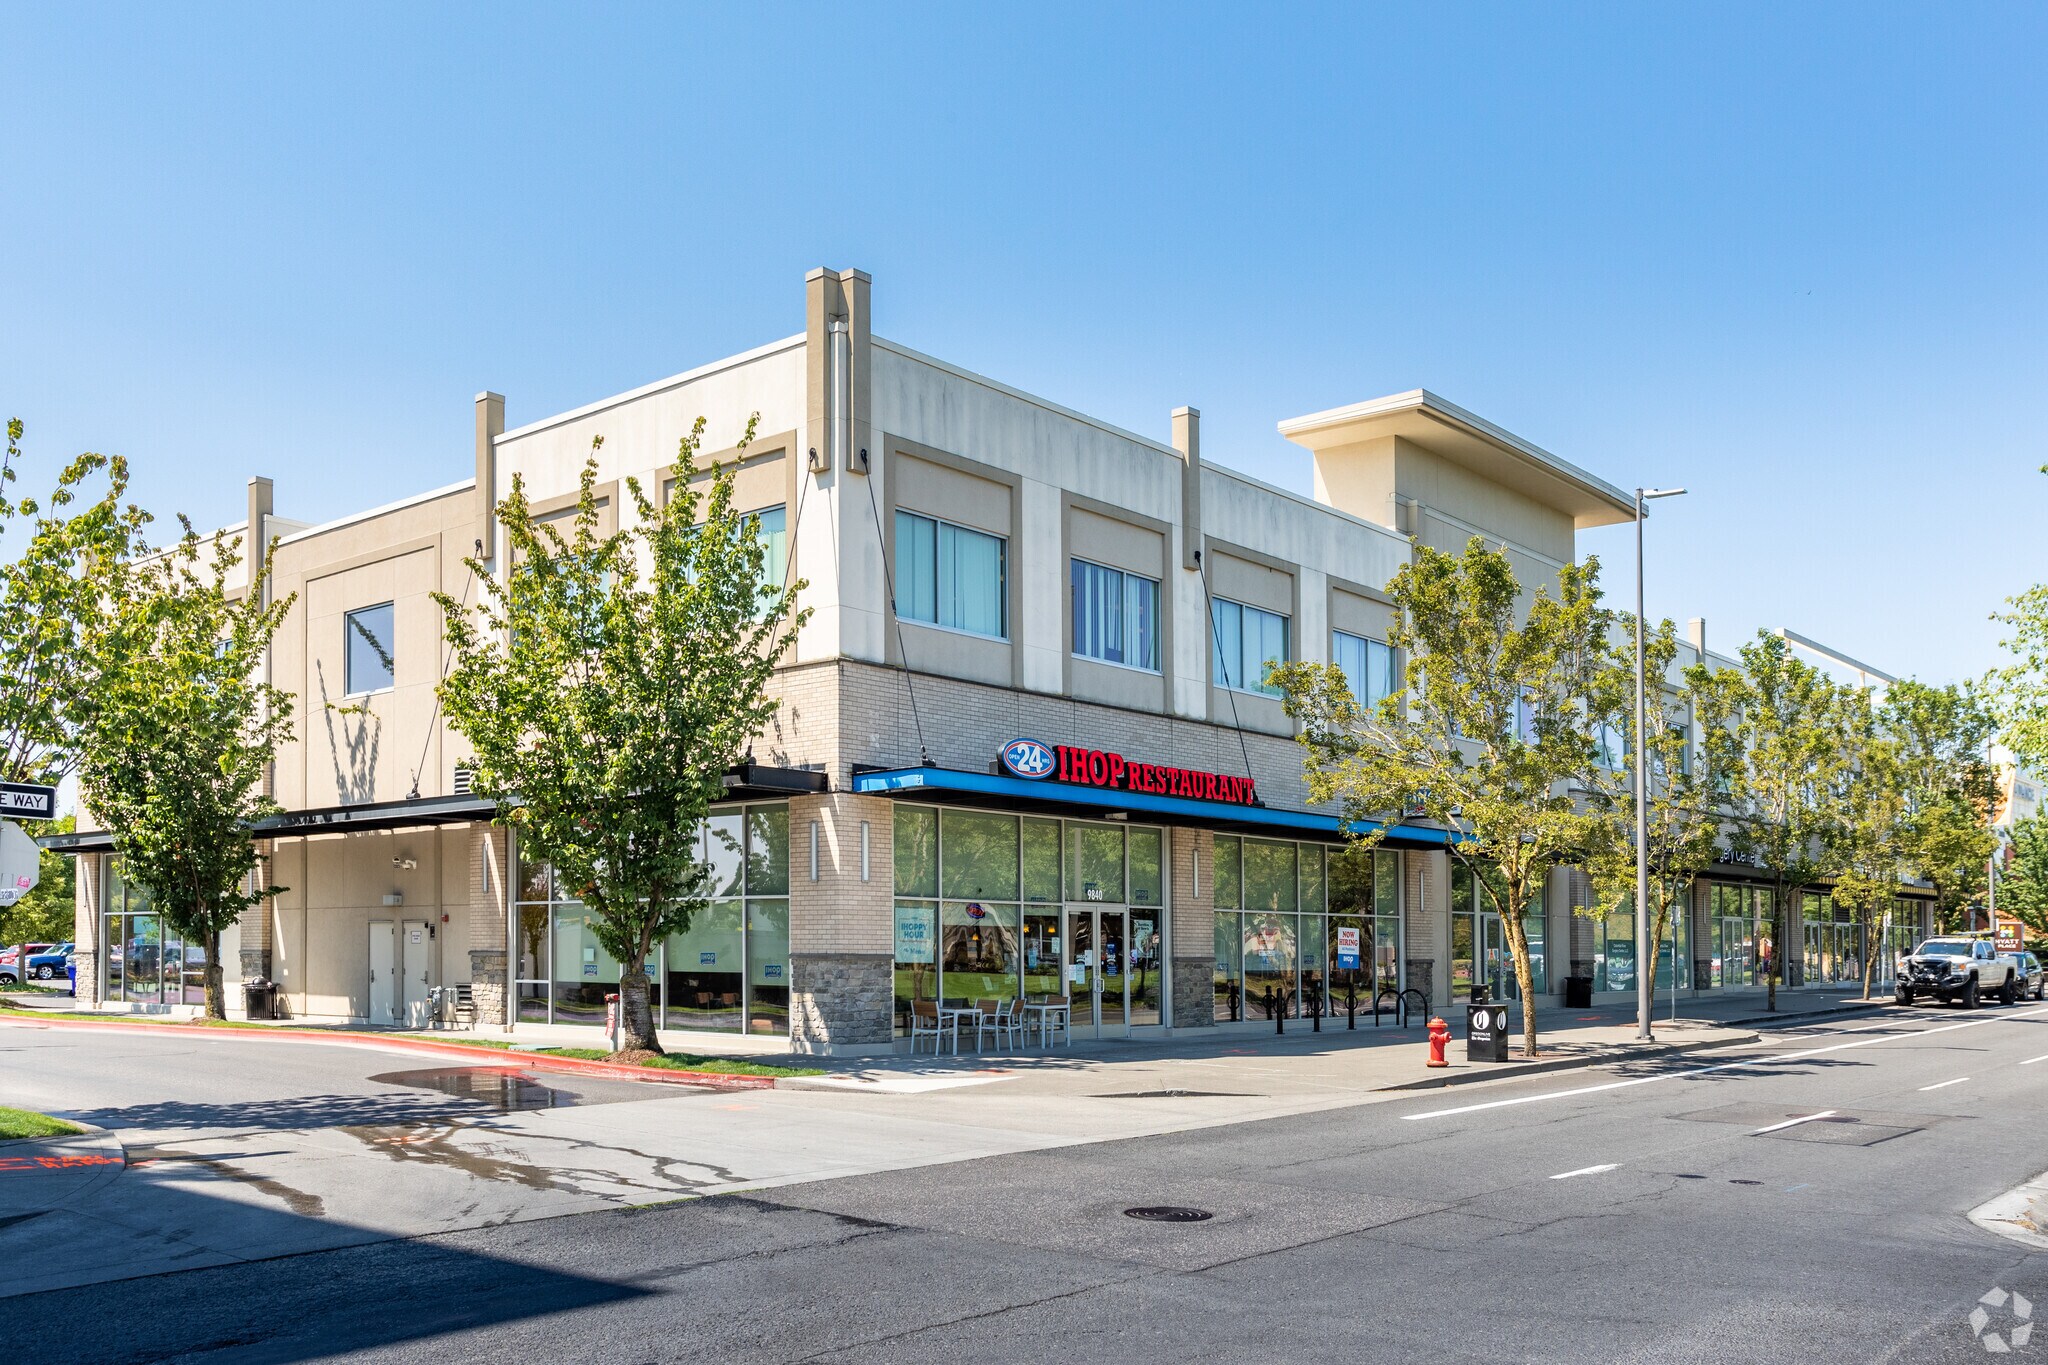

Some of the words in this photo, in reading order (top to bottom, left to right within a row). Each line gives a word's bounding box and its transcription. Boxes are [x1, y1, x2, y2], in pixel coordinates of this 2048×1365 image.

[1017, 743, 1043, 774] 24
[1058, 745, 1125, 787] IHOP
[1127, 762, 1255, 804] RESTAURANT
[14, 794, 43, 808] WAY
[1087, 889, 1103, 900] 9840
[901, 923, 927, 931] IHOPPY
[904, 931, 924, 939] HOUR
